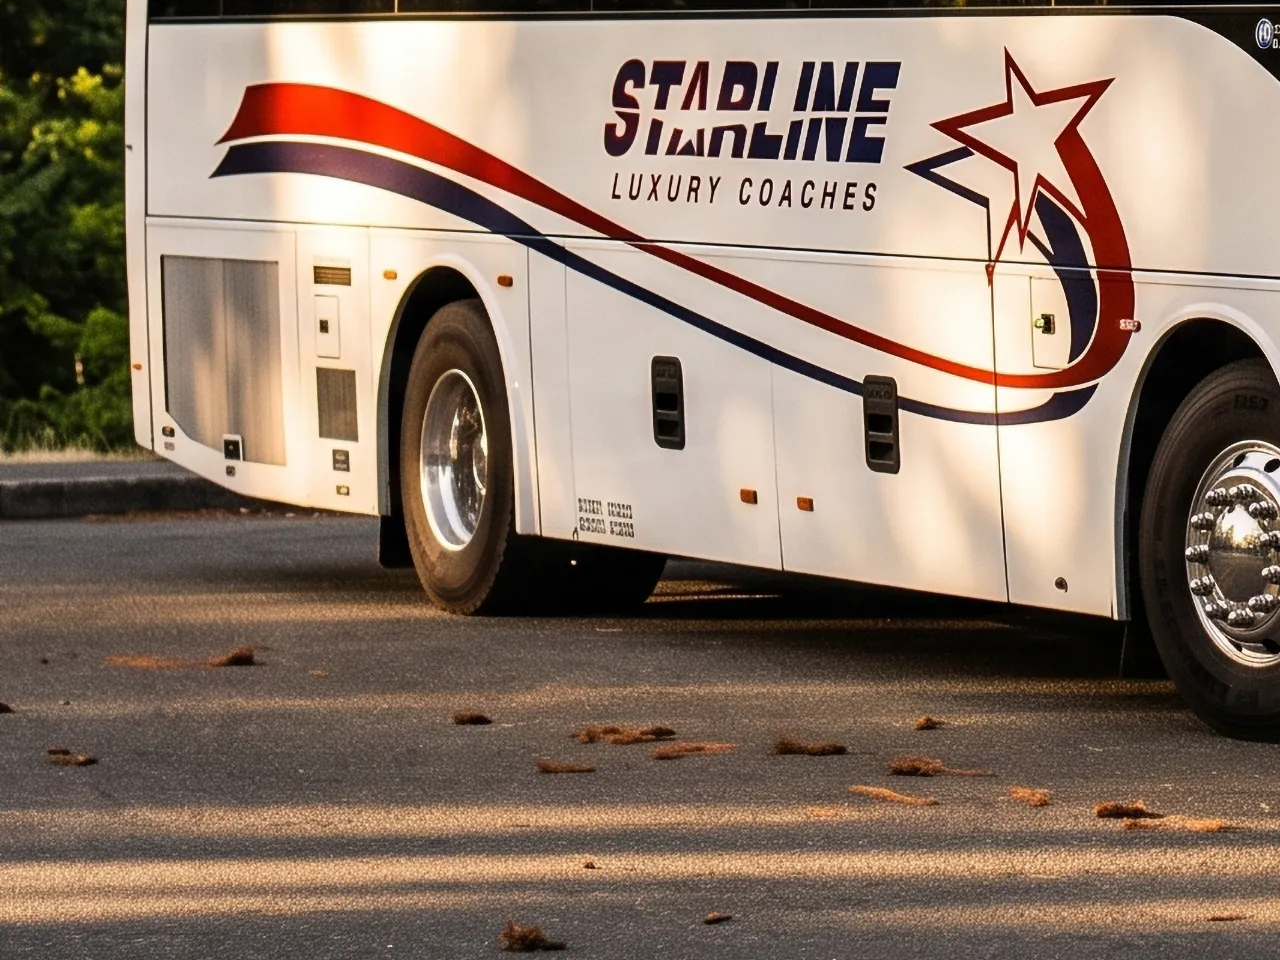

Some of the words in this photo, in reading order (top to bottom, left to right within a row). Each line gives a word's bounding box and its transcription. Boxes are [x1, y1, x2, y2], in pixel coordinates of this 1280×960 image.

[603, 58, 902, 164] STARLINE
[611, 172, 721, 204] LUXURY
[738, 176, 877, 212] COACHES
